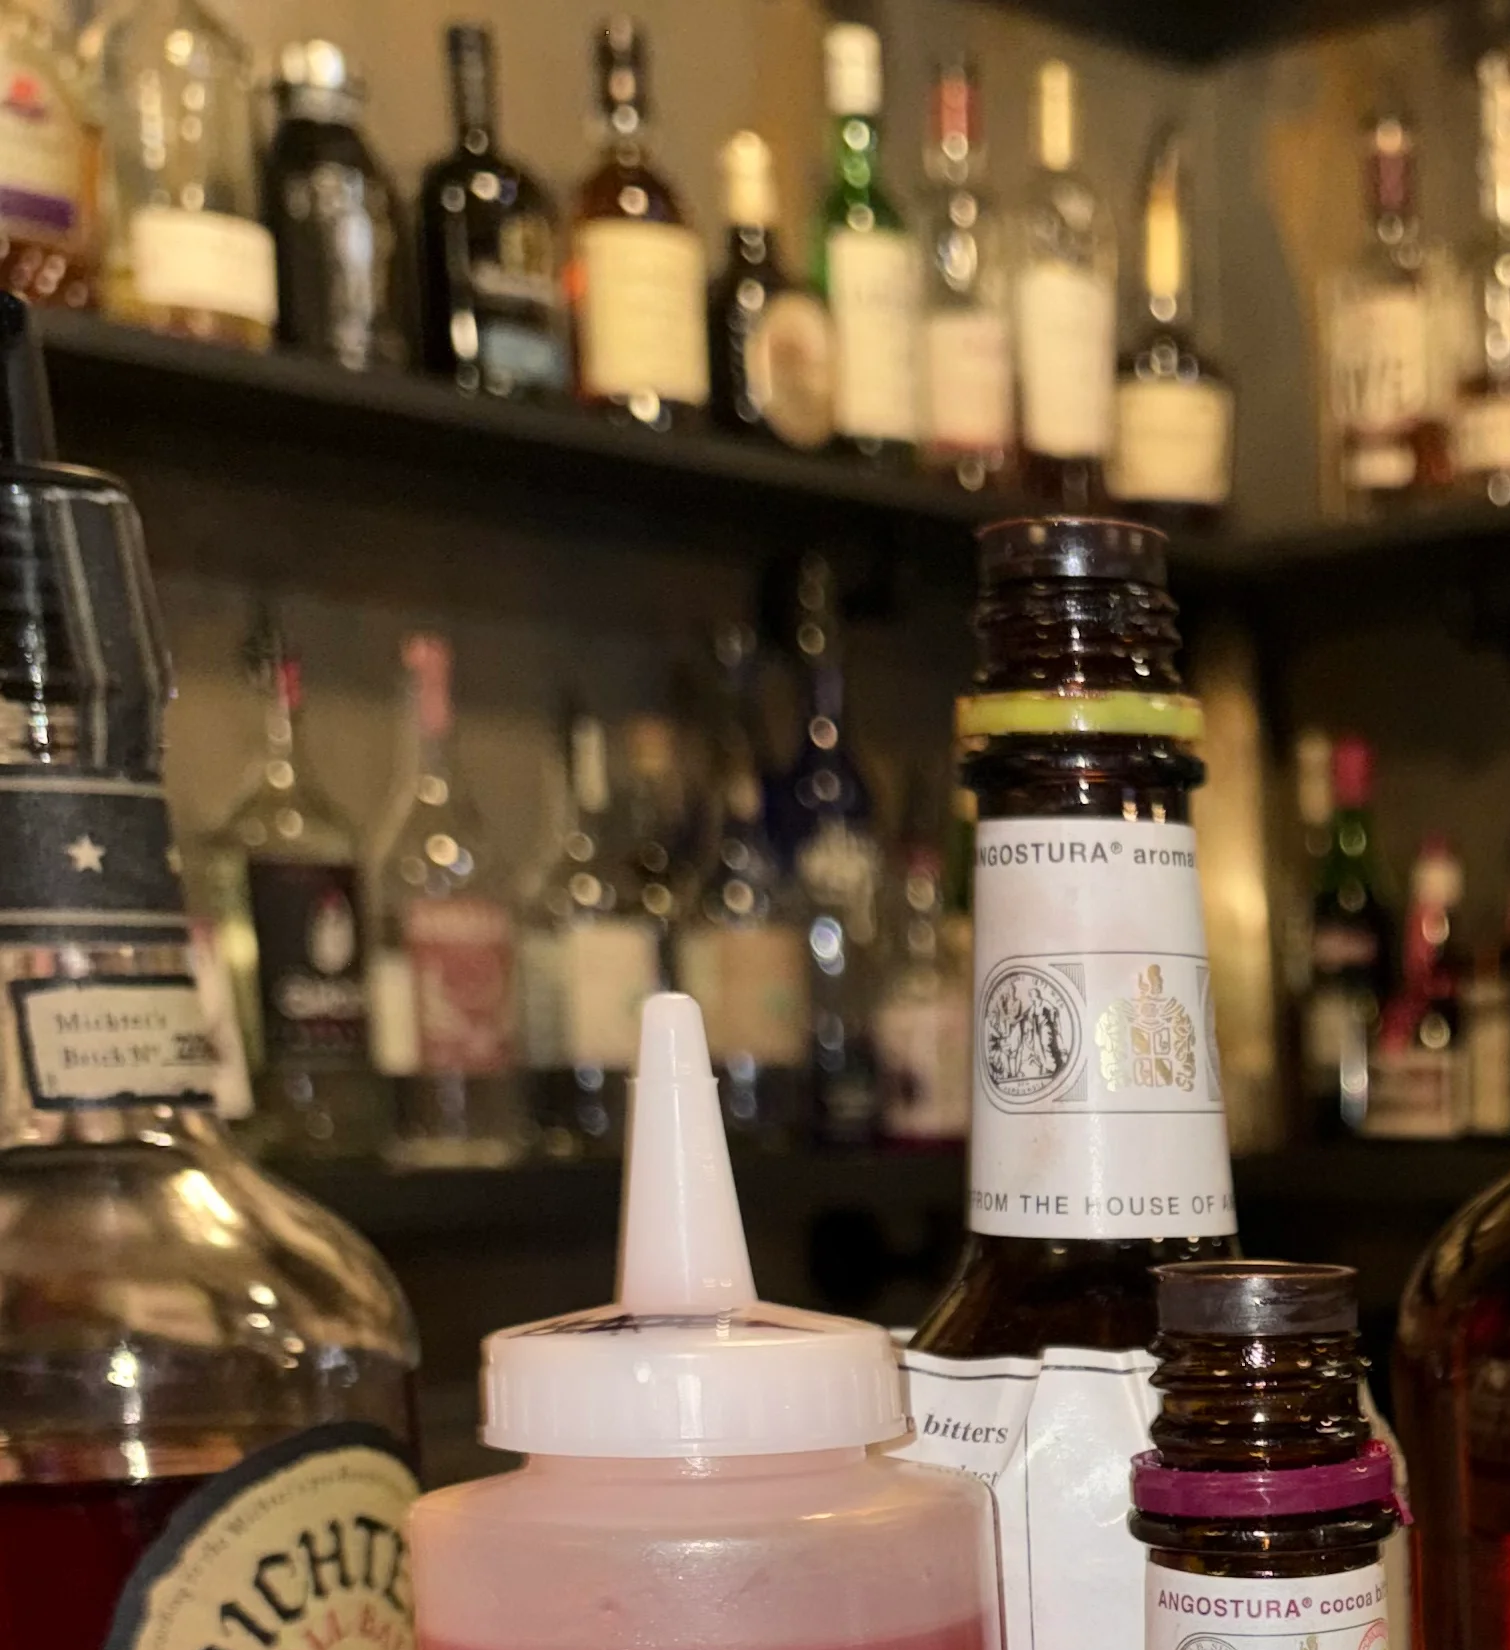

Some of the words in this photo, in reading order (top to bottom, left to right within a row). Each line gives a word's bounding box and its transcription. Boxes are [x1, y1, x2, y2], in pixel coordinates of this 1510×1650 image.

[1020, 1195, 1069, 1214] THE
[1085, 1196, 1180, 1216] HOUSE
[1192, 1196, 1215, 1214] OF
[923, 1411, 1009, 1444] bitters
[1320, 1591, 1373, 1615] cocoa
